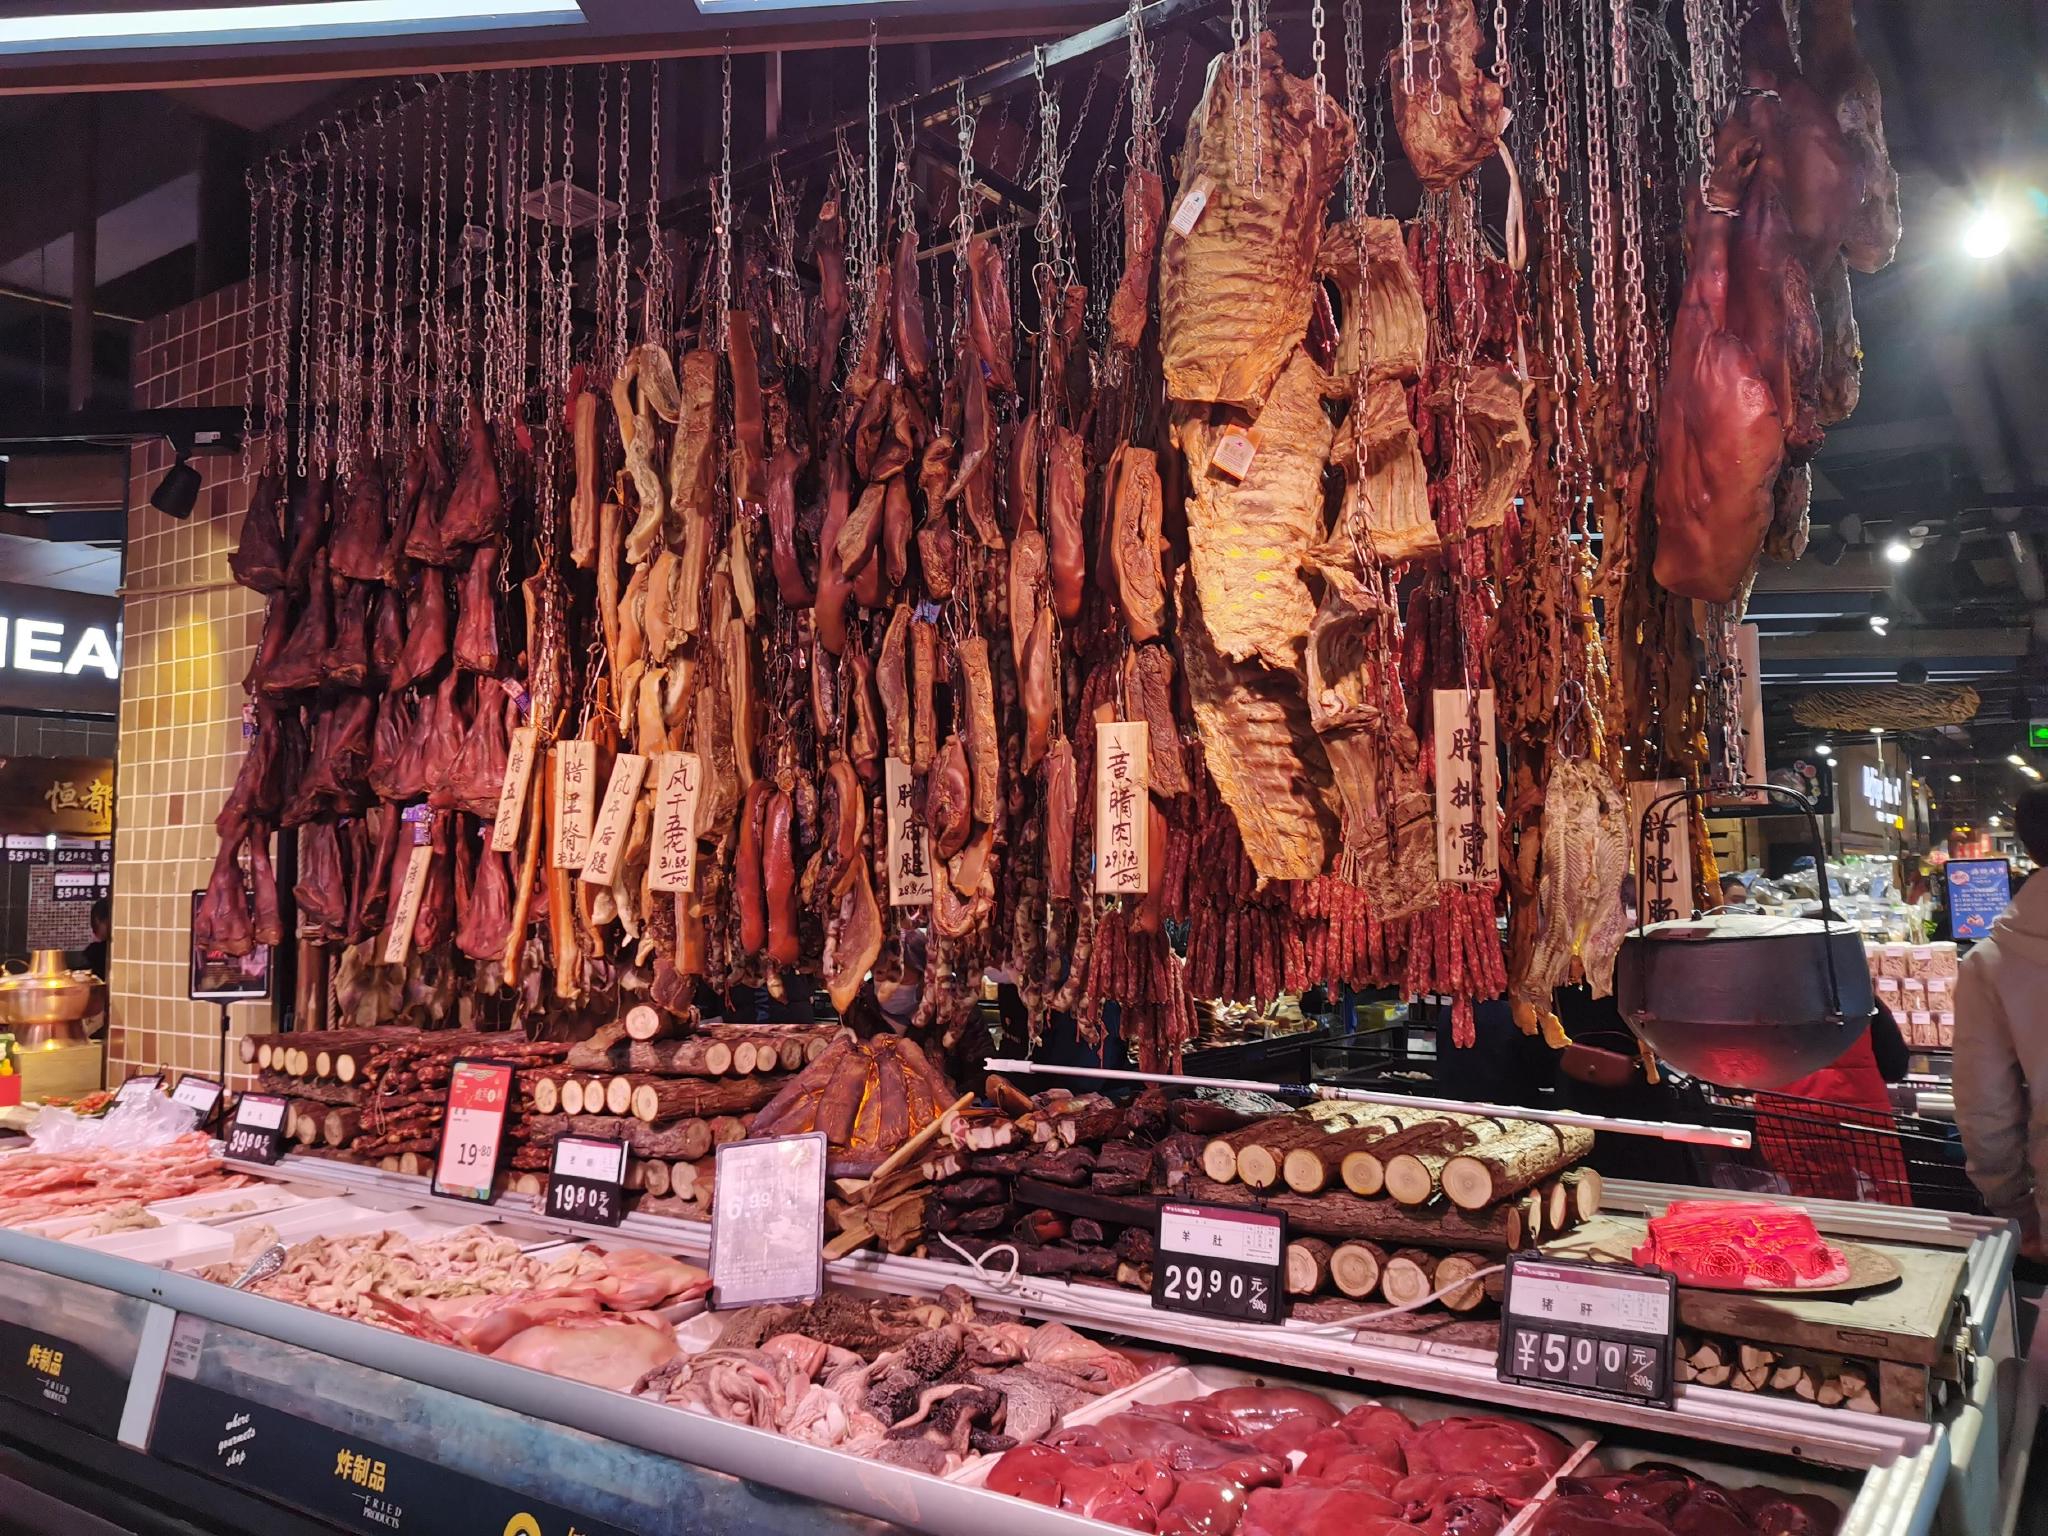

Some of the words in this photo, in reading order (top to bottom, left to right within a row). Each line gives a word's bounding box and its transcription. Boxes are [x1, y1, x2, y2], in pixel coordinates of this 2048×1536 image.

[663, 767, 694, 854] 风干五花
[554, 1184, 598, 1211] 19.80
[726, 1191, 771, 1220] 6.99
[1164, 1264, 1244, 1301] 29.90
[26, 1343, 64, 1377] 炸制品
[1516, 1331, 1621, 1374] ¥5.00
[225, 1412, 251, 1431] where
[217, 1426, 257, 1456] gourmets
[225, 1449, 247, 1468] shop
[334, 1447, 388, 1494] 炸制品
[361, 1506, 400, 1529] PRODUCTS
[363, 1494, 403, 1517] FRIED
